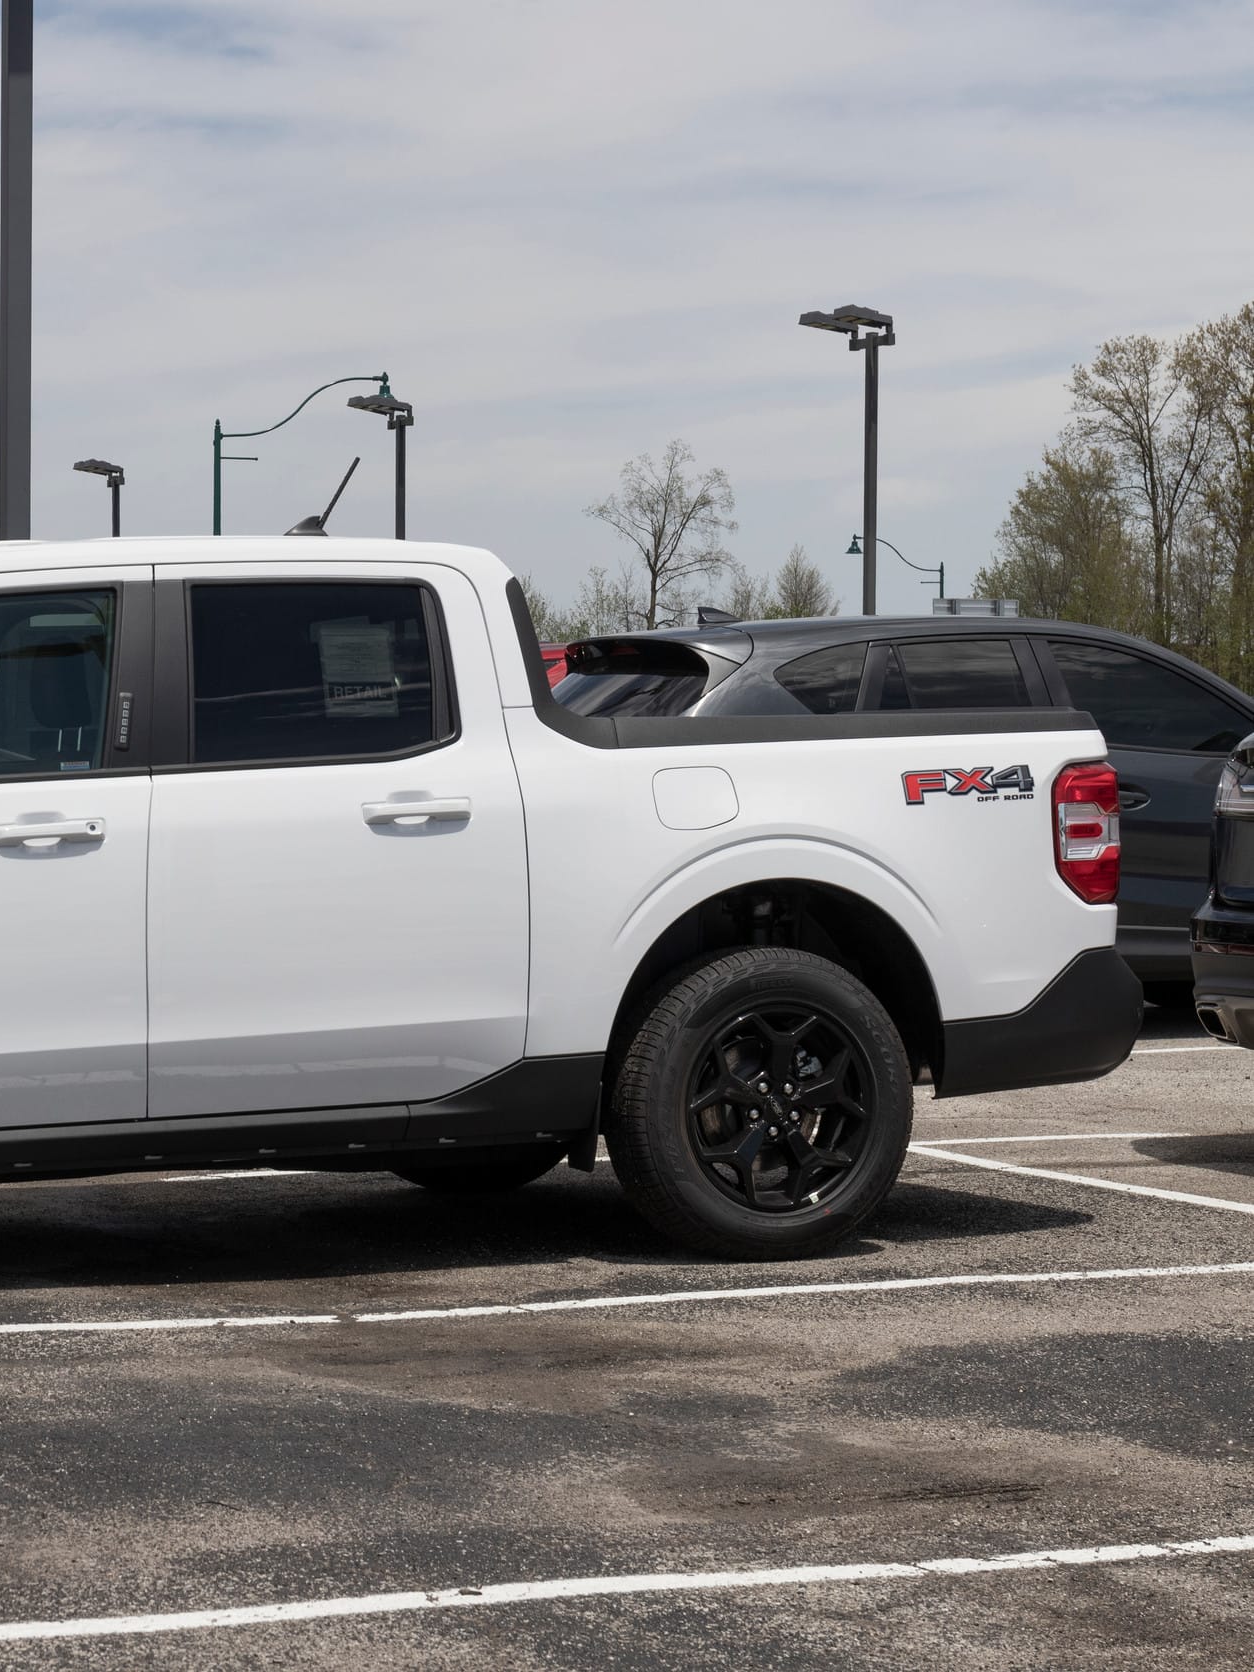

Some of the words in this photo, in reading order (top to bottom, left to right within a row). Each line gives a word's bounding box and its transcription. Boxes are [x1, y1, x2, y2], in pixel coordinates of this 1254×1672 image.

[333, 685, 387, 699] RETAIL
[901, 764, 1035, 805] FX4
[977, 795, 1000, 803] OFF
[1003, 793, 1035, 802] ROAD
